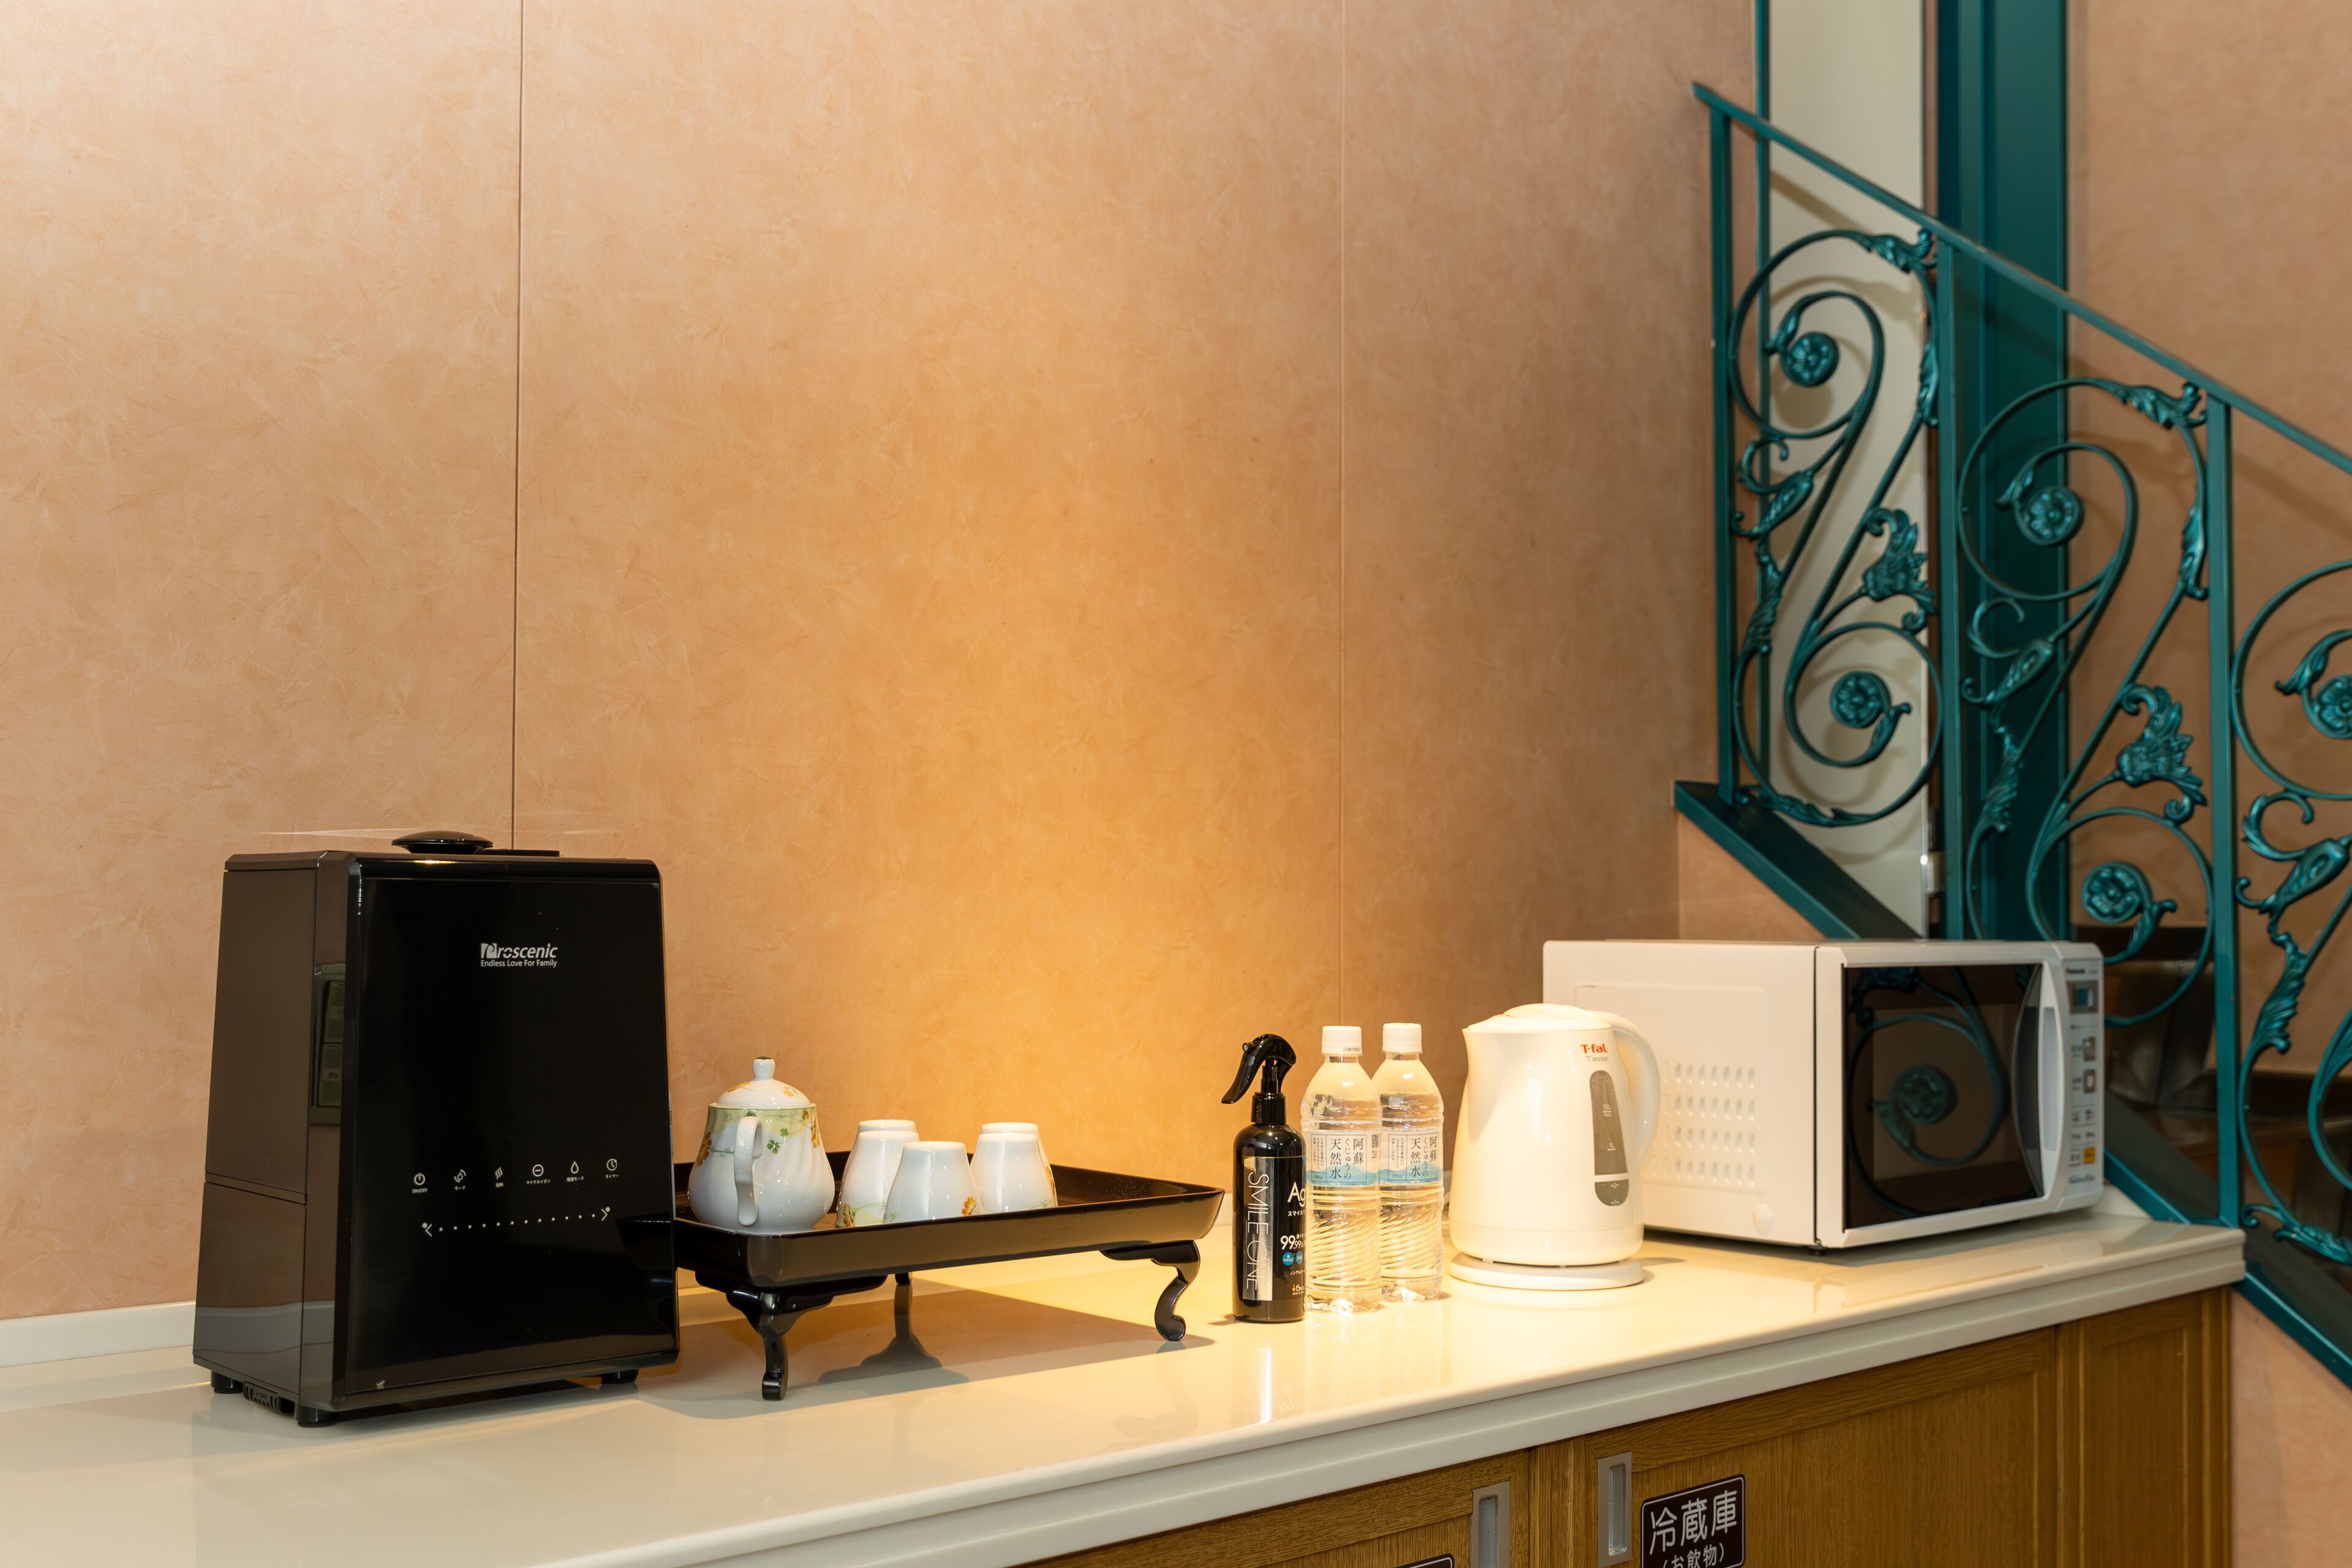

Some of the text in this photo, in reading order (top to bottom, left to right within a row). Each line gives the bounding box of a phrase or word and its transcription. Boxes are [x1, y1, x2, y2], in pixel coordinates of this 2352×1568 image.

[537, 959, 557, 968] Family
[1329, 1137, 1342, 1180] 天然水
[1343, 1137, 1352, 1180] くじゅうの
[1352, 1137, 1365, 1165] 阿蘇
[1410, 1137, 1421, 1177] 天然水
[1429, 1136, 1438, 1163] 阿蘇
[1246, 1172, 1270, 1290] SMILE ONE
[1649, 1489, 1738, 1556] 冷蔵庫
